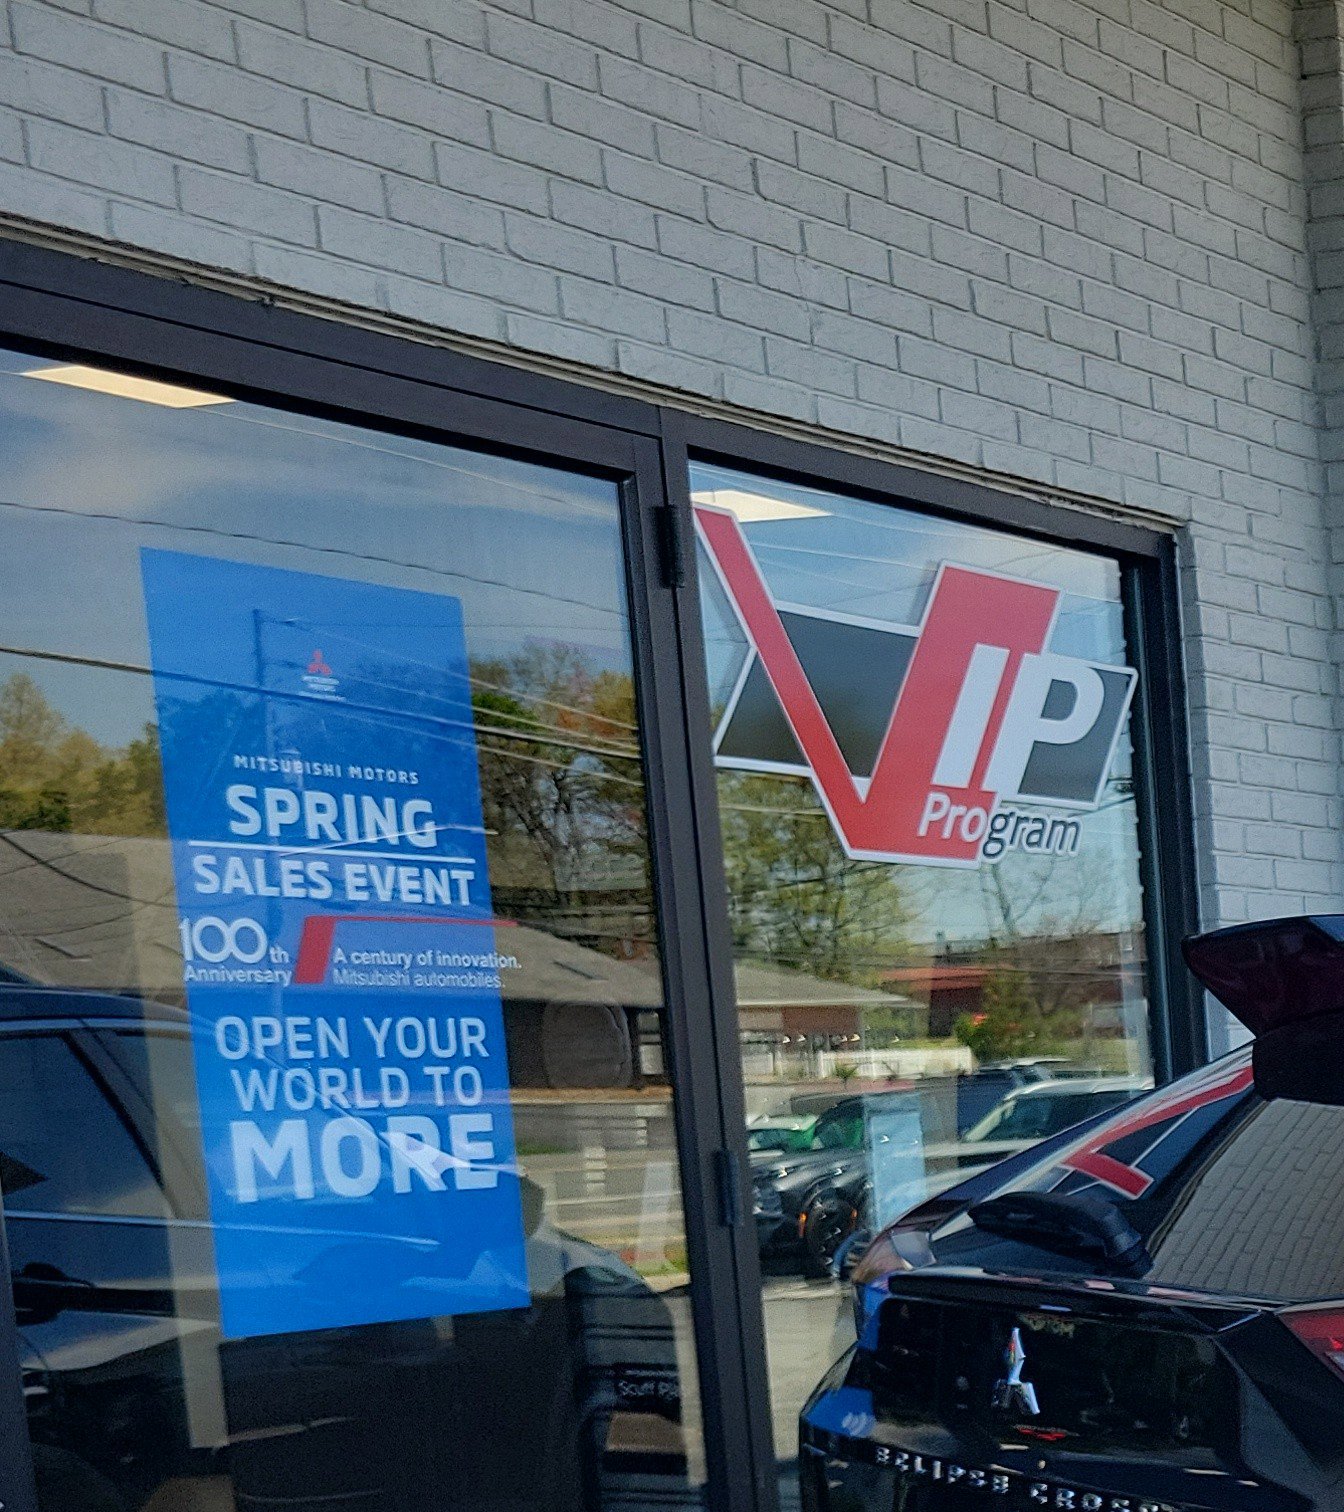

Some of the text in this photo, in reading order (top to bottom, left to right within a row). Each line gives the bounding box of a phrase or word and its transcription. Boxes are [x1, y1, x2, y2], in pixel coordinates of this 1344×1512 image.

[693, 508, 1105, 860] VIP
[233, 753, 419, 785] MITSUBISHI MOTORS
[225, 784, 438, 849] SPRING
[918, 792, 1081, 861] Program
[191, 854, 475, 907] SALES EVENT
[184, 966, 293, 986] Anniversary
[332, 967, 411, 986] Mitsubishi
[333, 948, 522, 970] A century of innovation.
[214, 1015, 490, 1060] OPEN YOUR
[230, 1065, 483, 1112] WORLD TO
[229, 1112, 499, 1204] MORE
